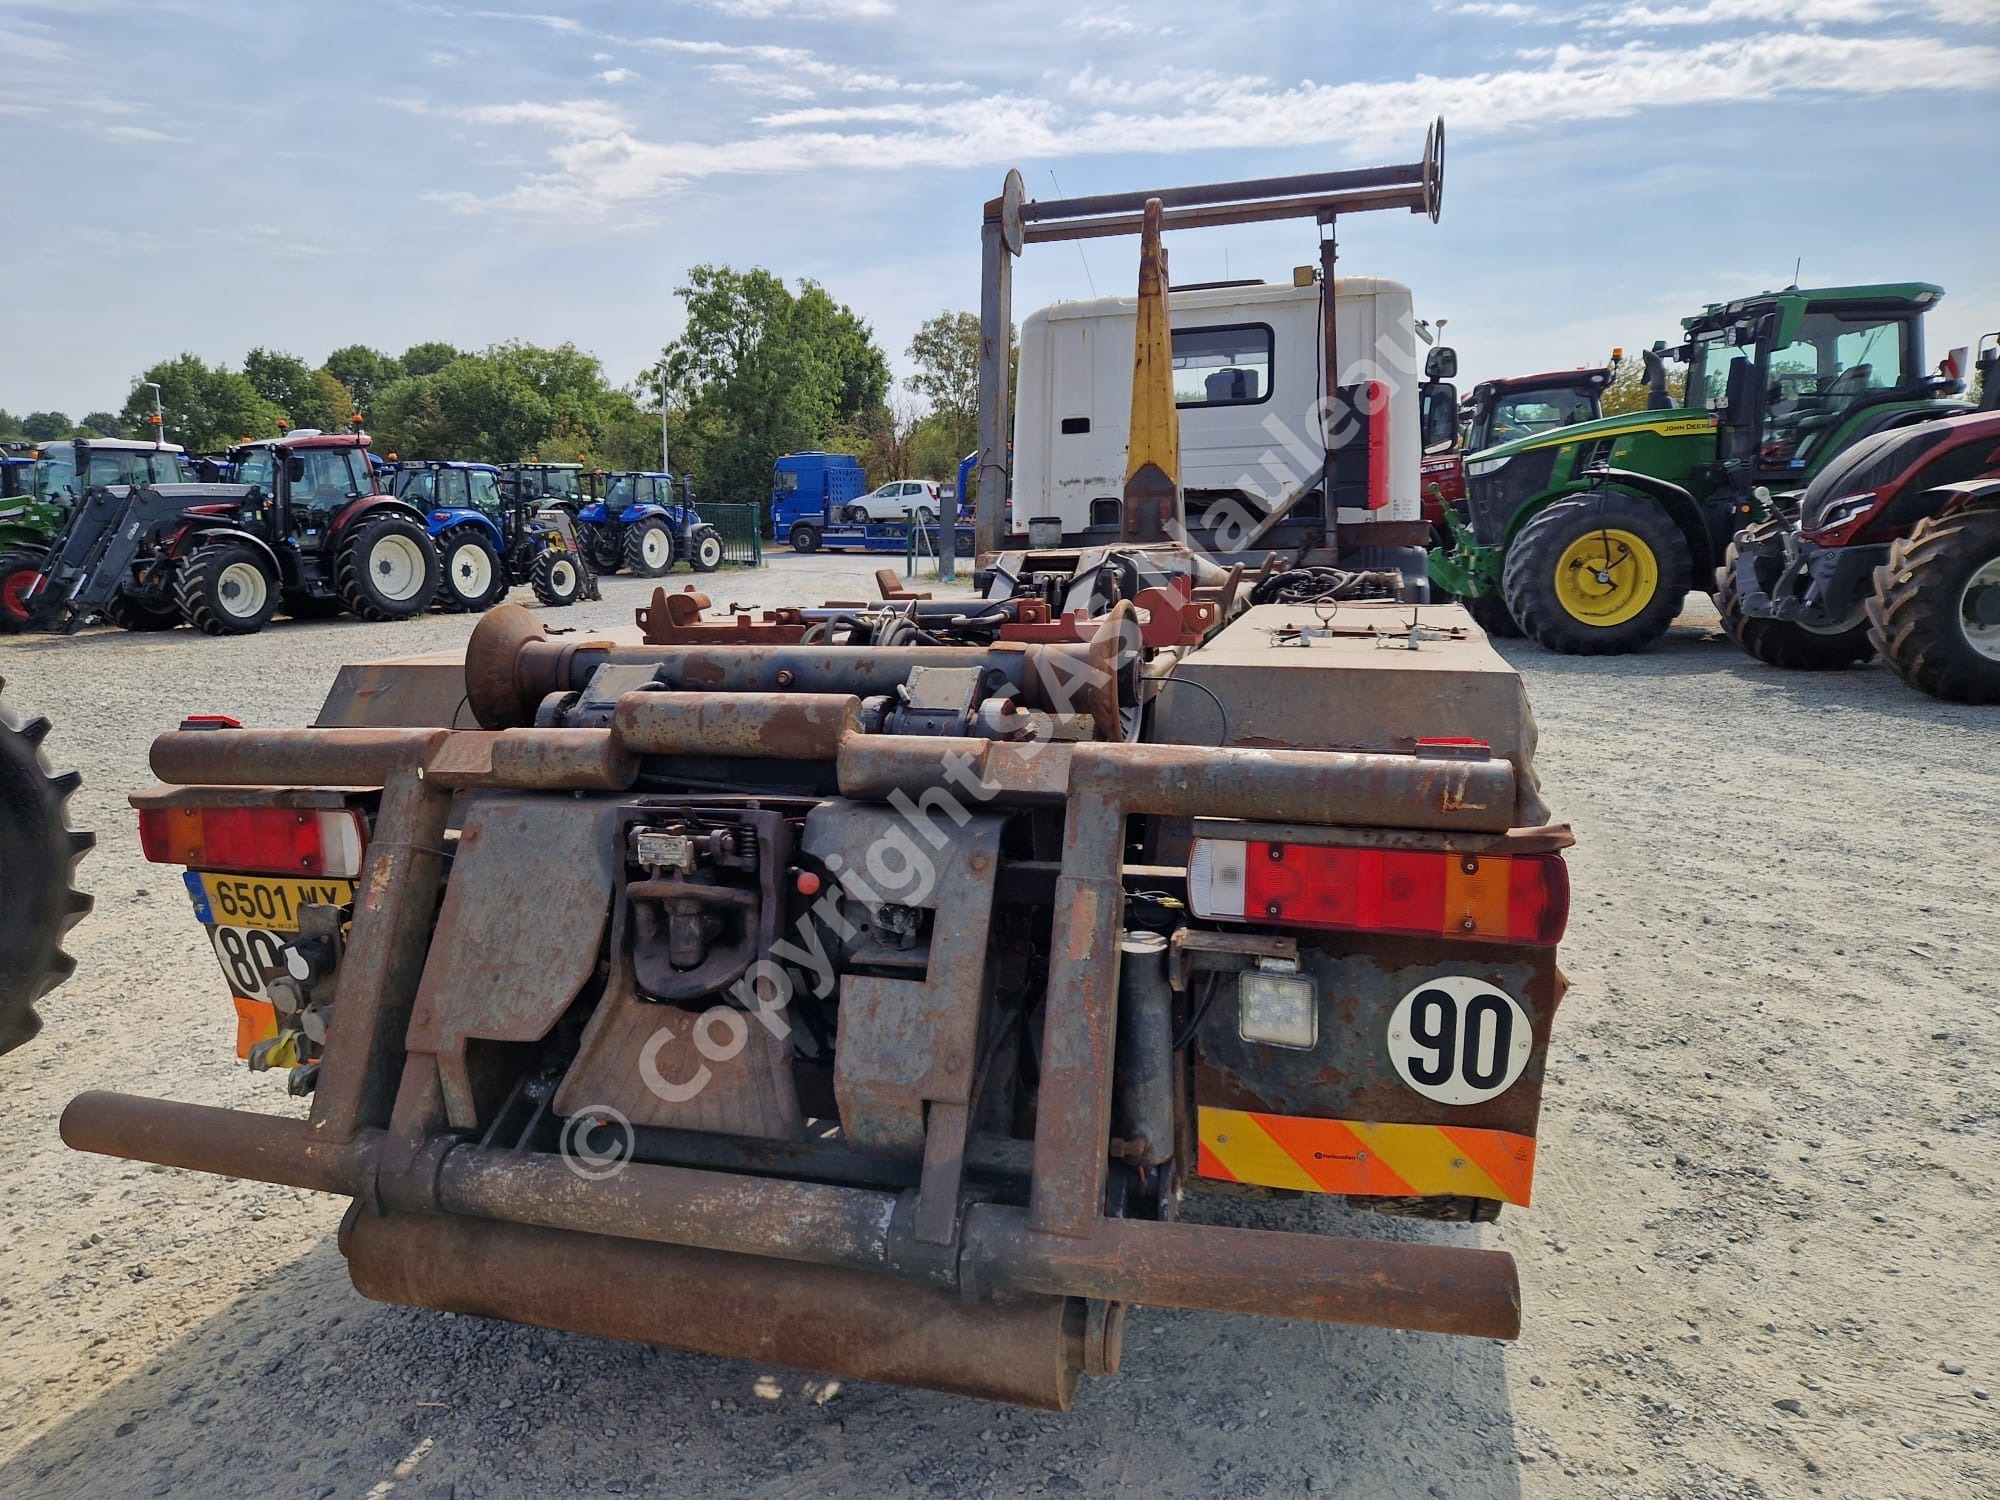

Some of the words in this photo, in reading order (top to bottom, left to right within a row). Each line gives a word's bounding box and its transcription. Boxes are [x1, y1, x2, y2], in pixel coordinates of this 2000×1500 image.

[1420, 463, 1445, 474] CASE
[217, 881, 292, 921] 6501
[1408, 989, 1513, 1090] 90
